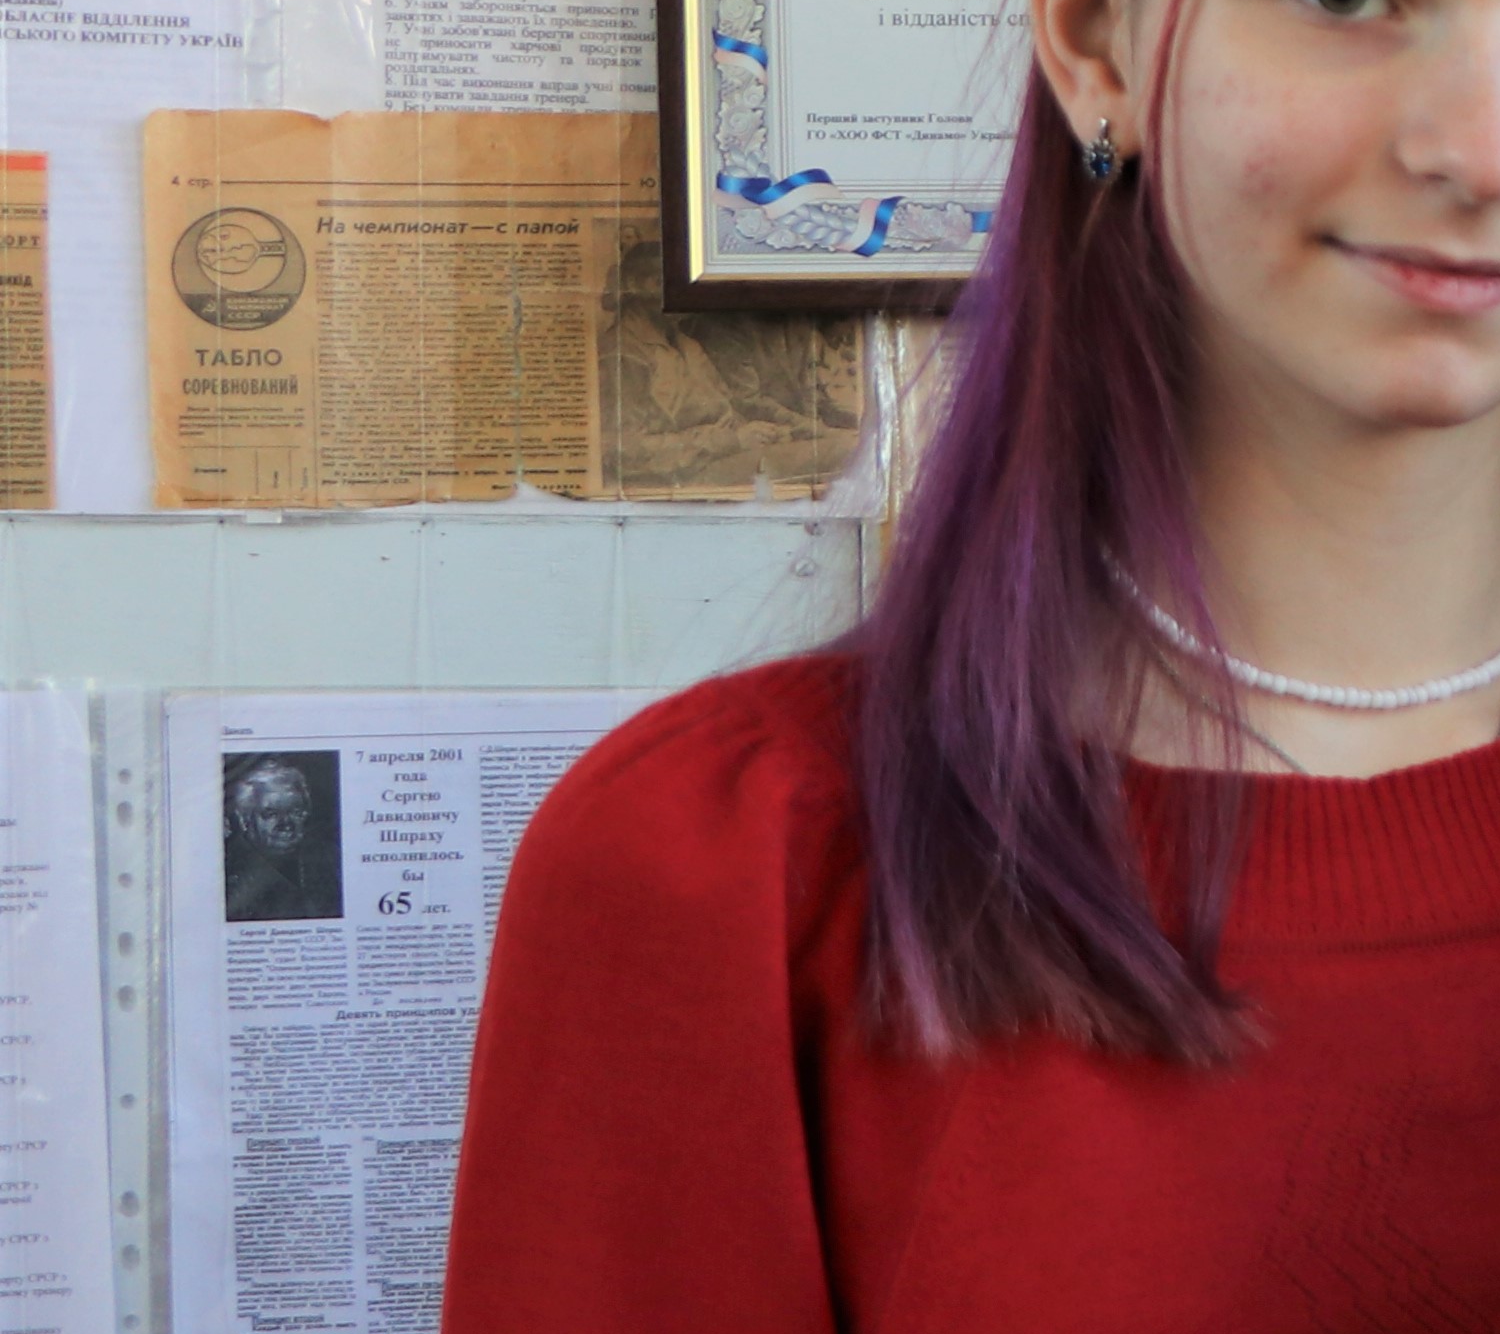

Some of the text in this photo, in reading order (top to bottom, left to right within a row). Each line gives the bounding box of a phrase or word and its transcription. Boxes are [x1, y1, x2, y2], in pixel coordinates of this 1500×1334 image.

[878, 10, 885, 27] і
[806, 113, 857, 126] Перший
[806, 130, 826, 142] ГО
[316, 216, 580, 236] На чемпионат папой
[195, 348, 283, 368] ТАБЛО
[182, 377, 299, 396] СОРЕВНОВАНИЙ
[356, 748, 464, 766] 7 апреля 2001
[393, 771, 428, 785] года
[380, 788, 441, 805] Сергею
[363, 808, 460, 826] Давидовичу
[379, 828, 444, 847] Шпраху
[360, 850, 464, 864] исполнилось
[401, 868, 426, 883] бы
[377, 890, 413, 917] 65
